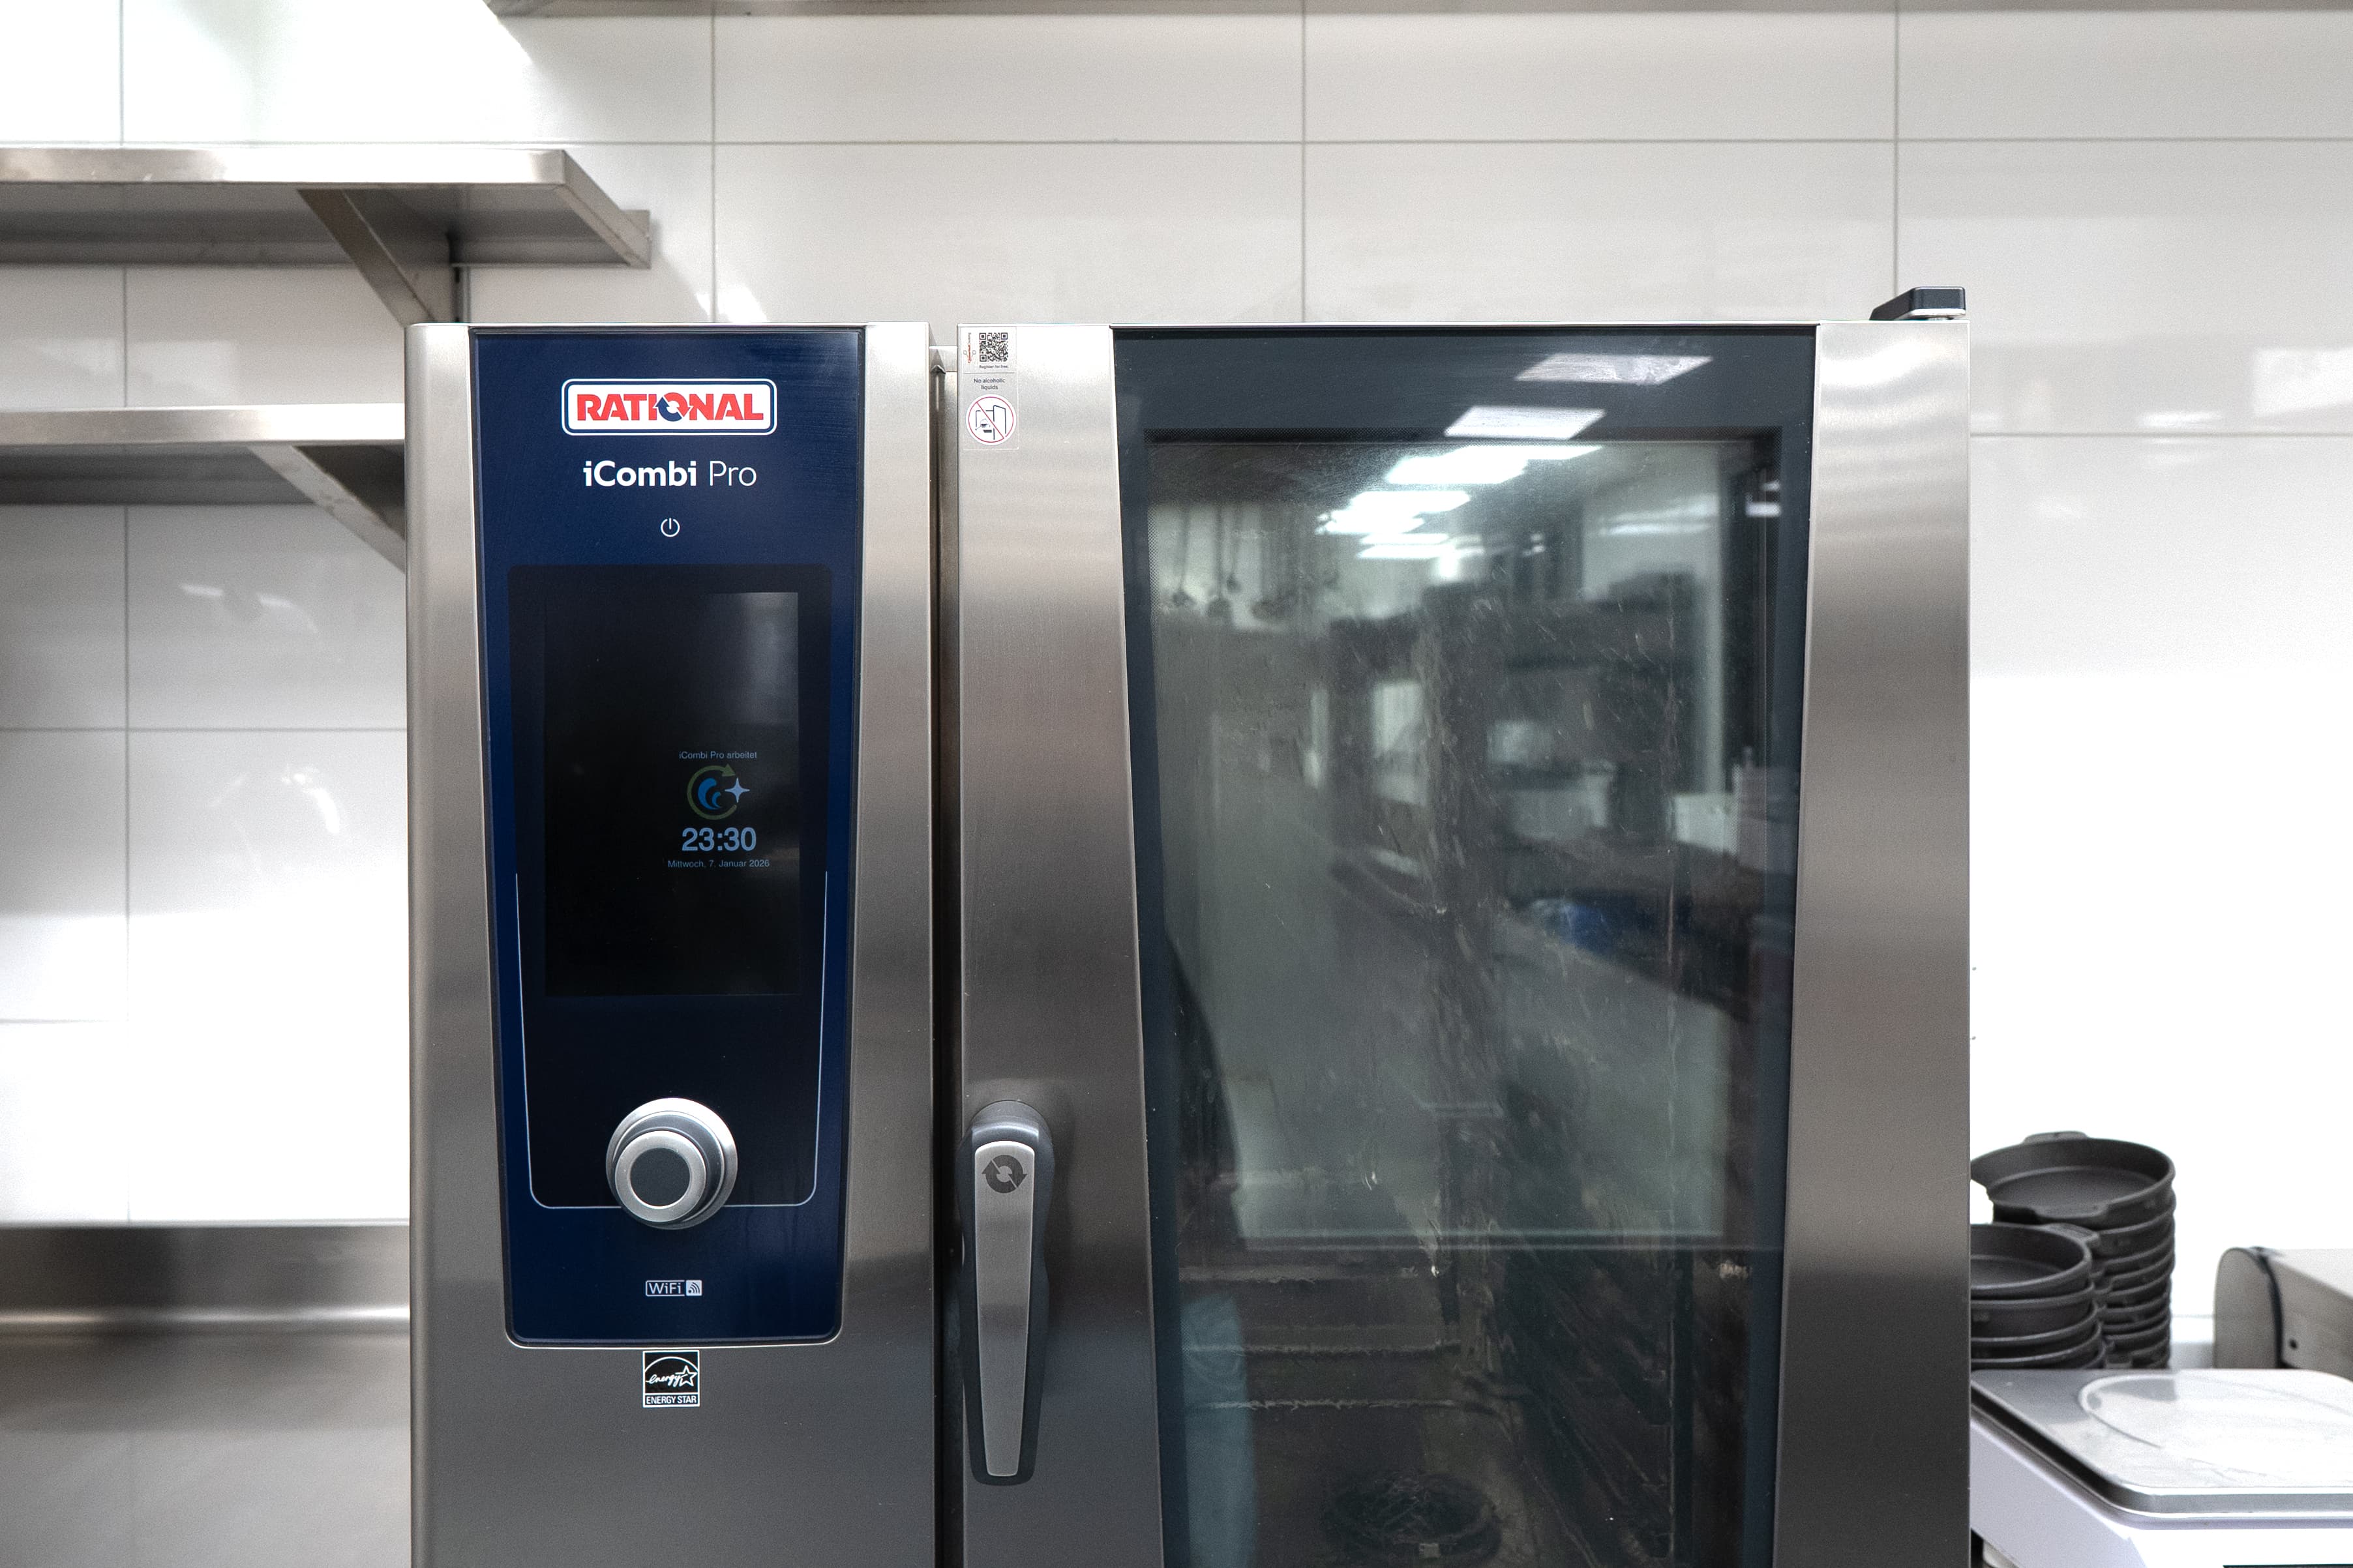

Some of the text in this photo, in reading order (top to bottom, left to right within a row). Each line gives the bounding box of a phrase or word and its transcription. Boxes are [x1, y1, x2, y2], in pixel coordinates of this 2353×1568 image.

[577, 392, 764, 422] RATIONAL
[582, 460, 757, 487] iCombi Pro
[682, 827, 757, 851] 23:30
[648, 1282, 682, 1294] WiFi
[646, 1395, 697, 1404] ENERGY STAR
